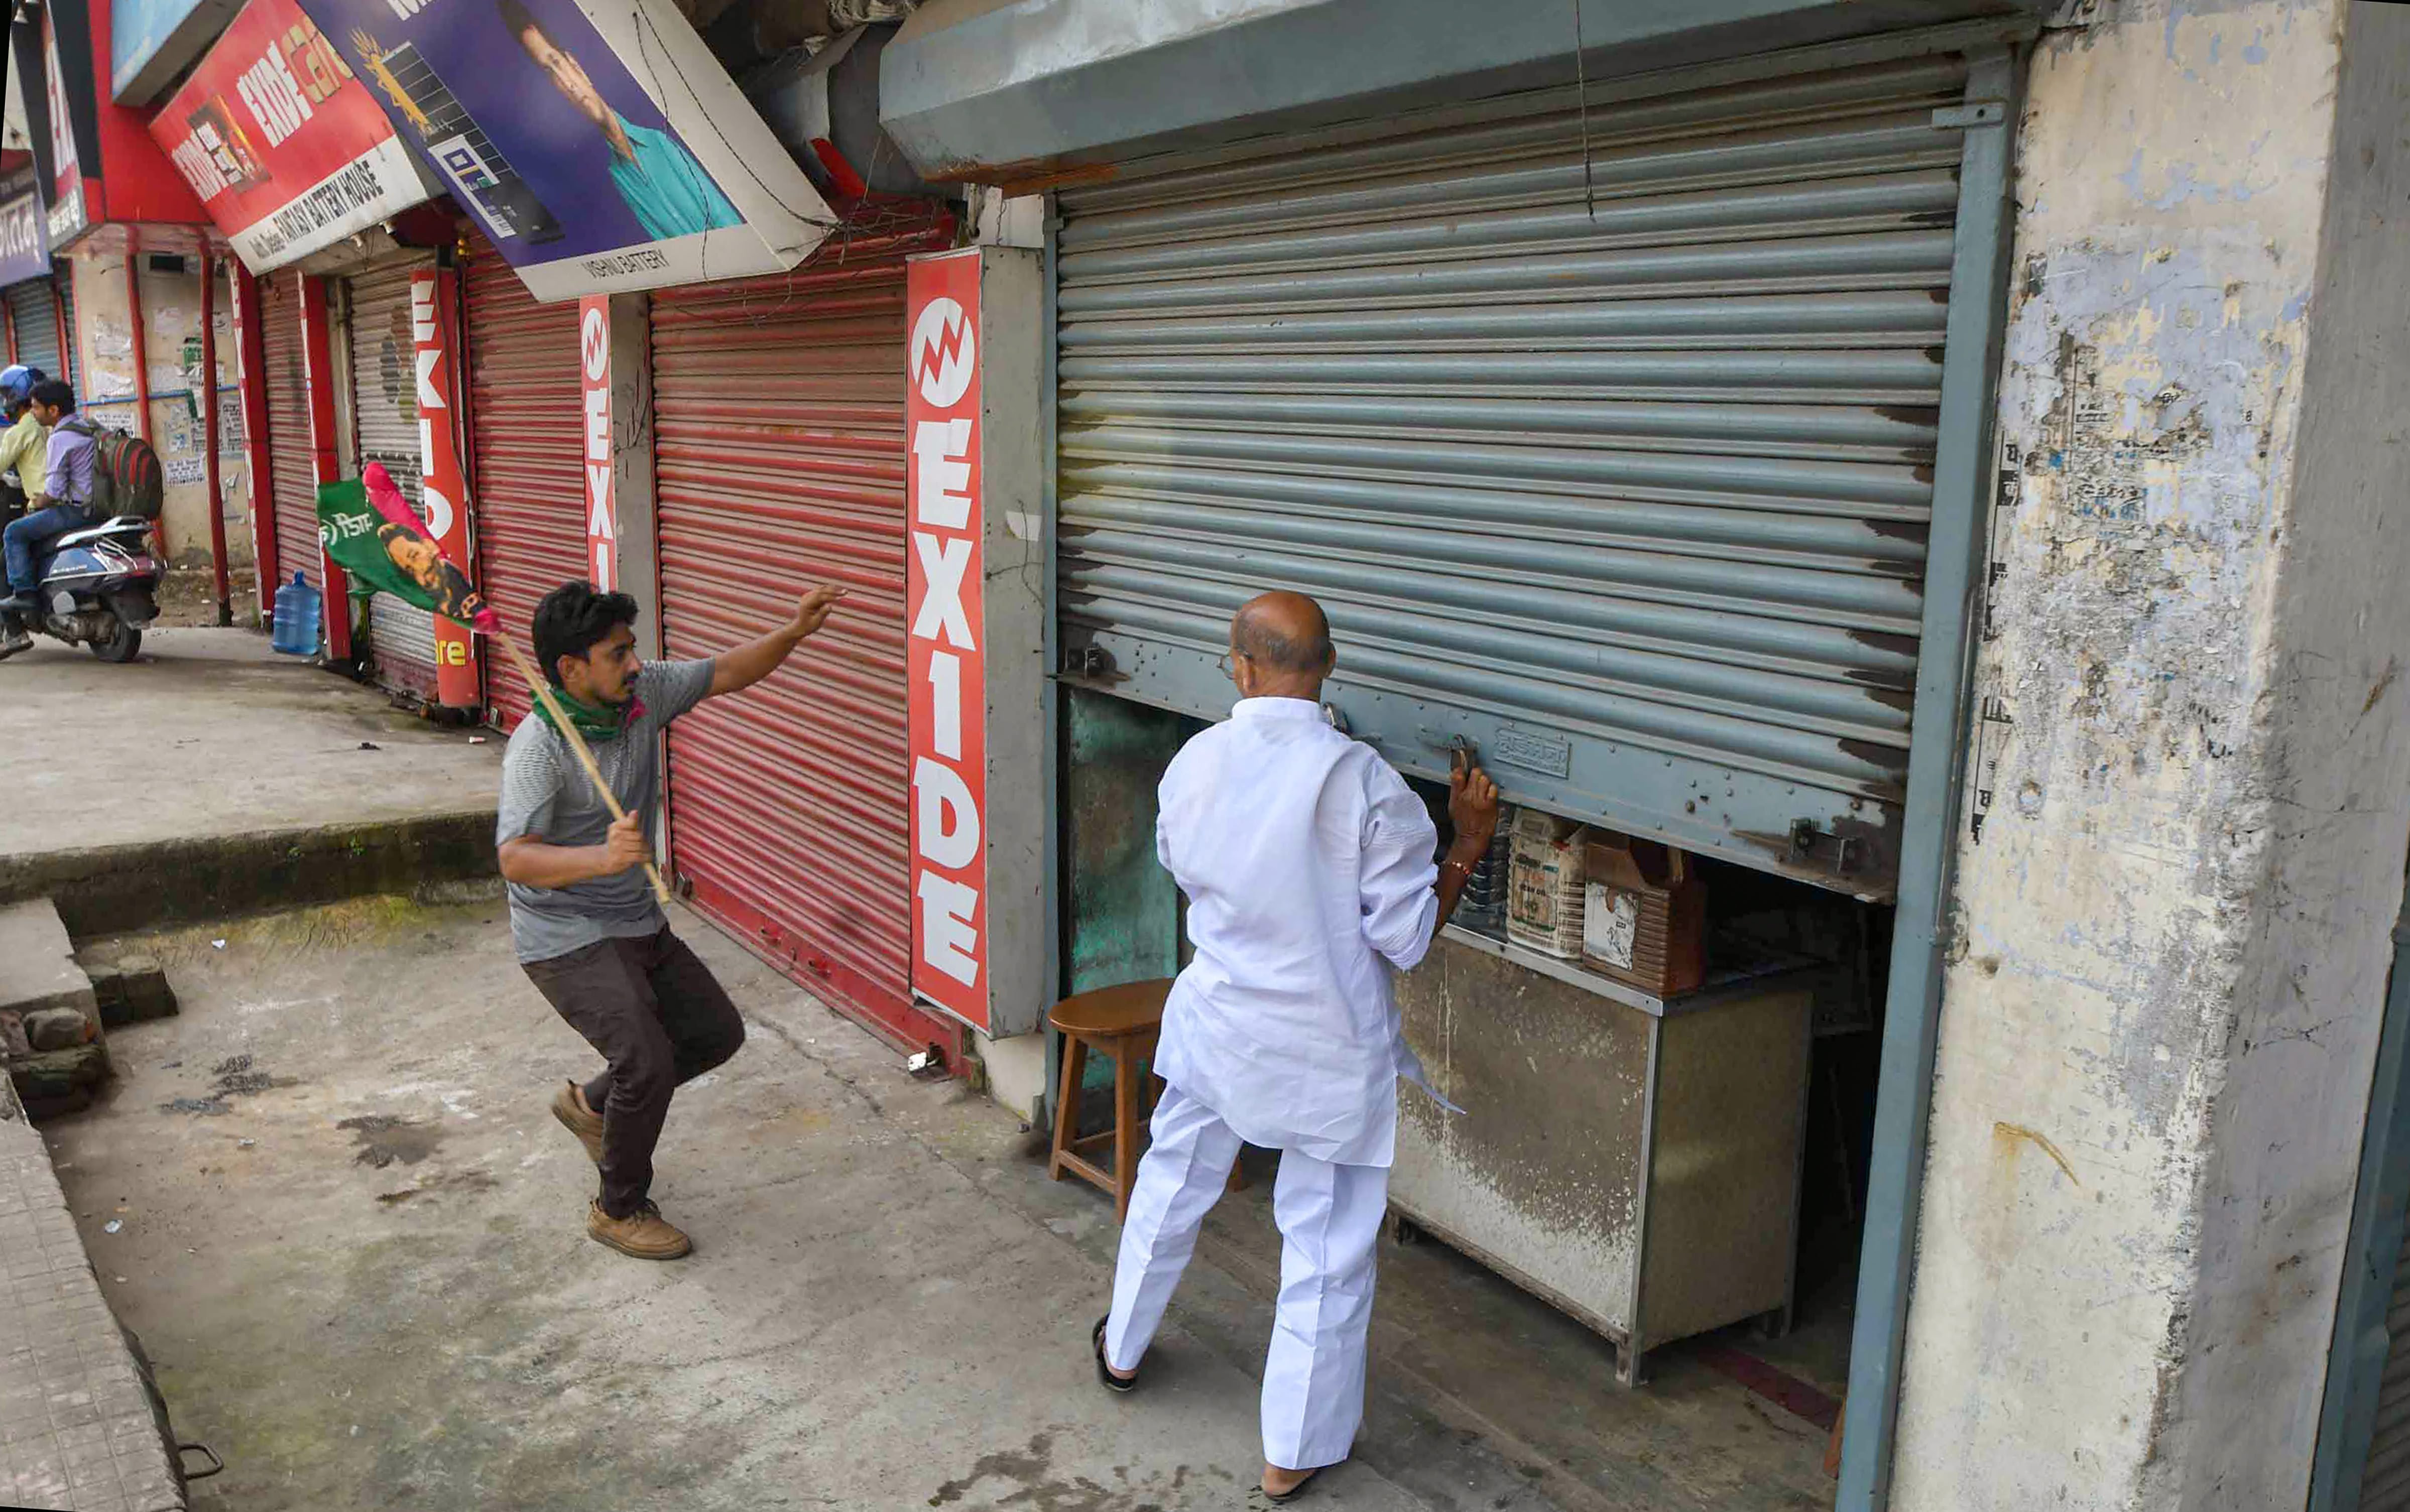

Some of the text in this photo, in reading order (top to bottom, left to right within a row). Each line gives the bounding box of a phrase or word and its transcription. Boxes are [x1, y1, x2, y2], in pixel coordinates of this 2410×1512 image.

[236, 40, 313, 149] EXIDE
[171, 128, 229, 202] EXIDE
[272, 202, 315, 243] FANTASY
[302, 179, 350, 228] BATTERY
[337, 159, 384, 210] HOUSE
[617, 248, 670, 273] BATTERY
[411, 280, 453, 541] EXID
[585, 387, 614, 595] EXI
[912, 418, 980, 988] EXIDE
